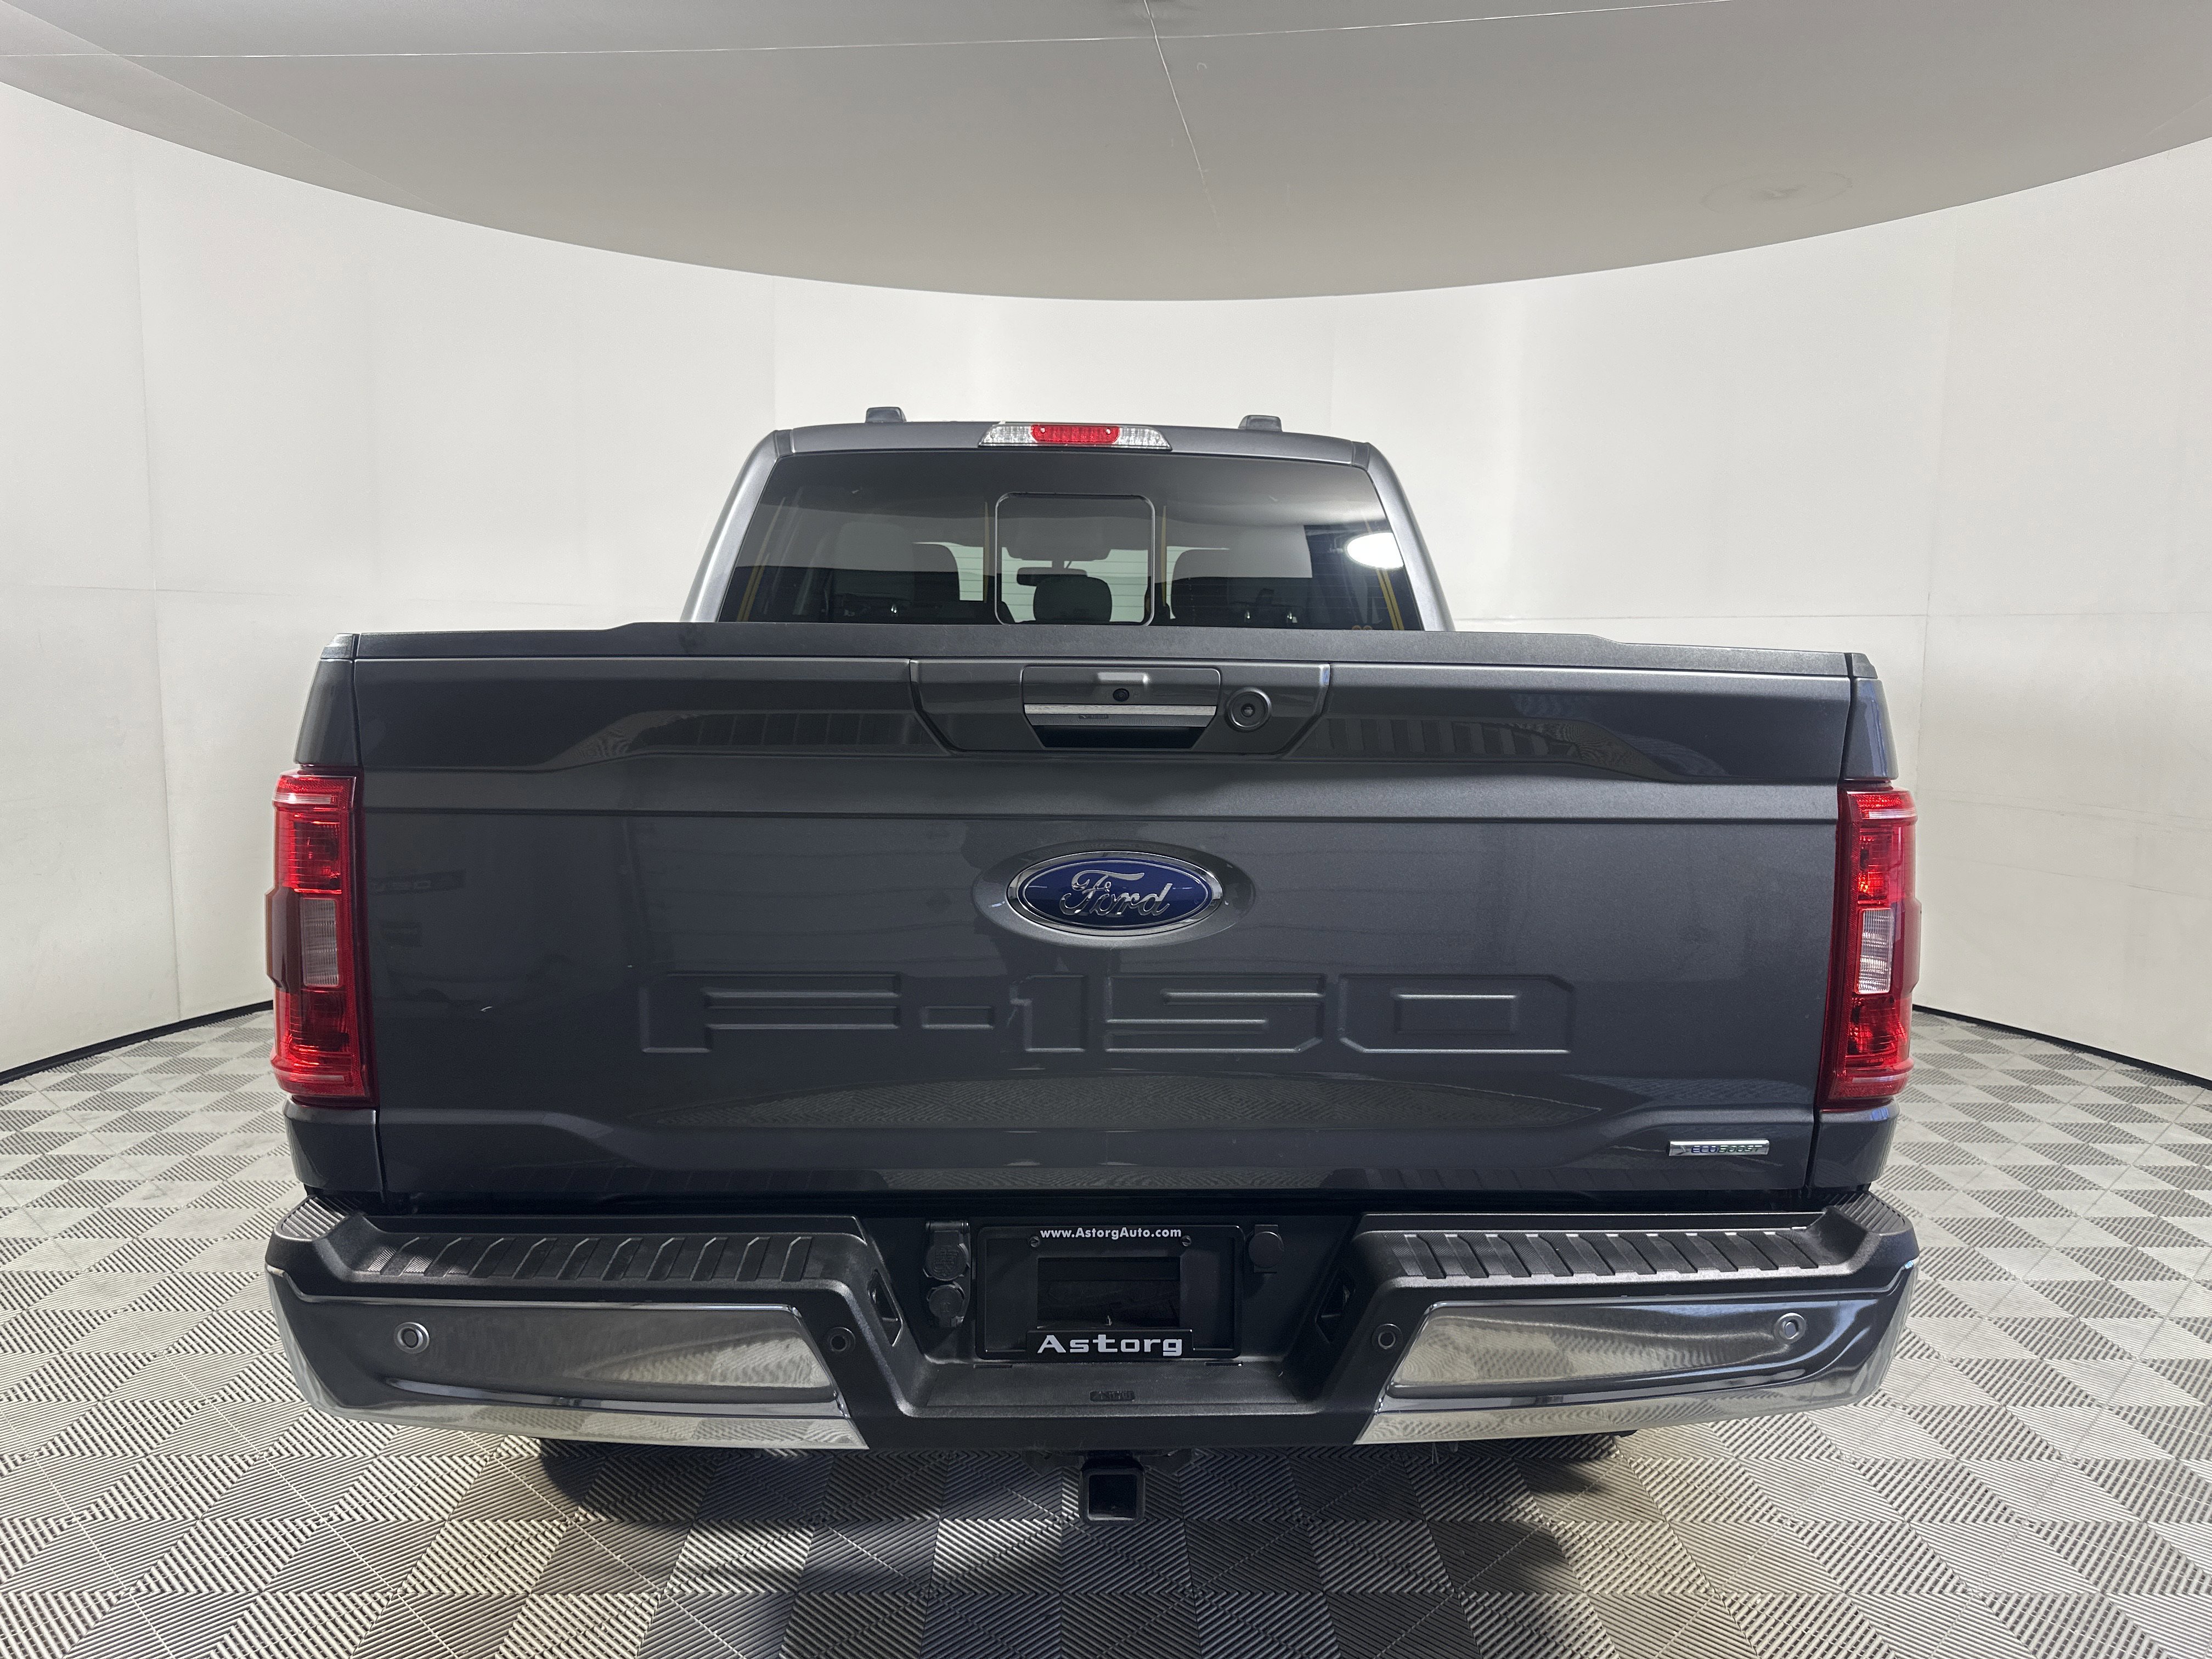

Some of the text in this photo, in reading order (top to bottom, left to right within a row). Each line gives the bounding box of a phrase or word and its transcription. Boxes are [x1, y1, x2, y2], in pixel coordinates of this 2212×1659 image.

[1059, 870, 1170, 916] Ford
[639, 971, 1575, 1054] F-150
[1040, 1227, 1182, 1240] www.AstorgAuto.com
[1037, 1334, 1182, 1356] Astorg
